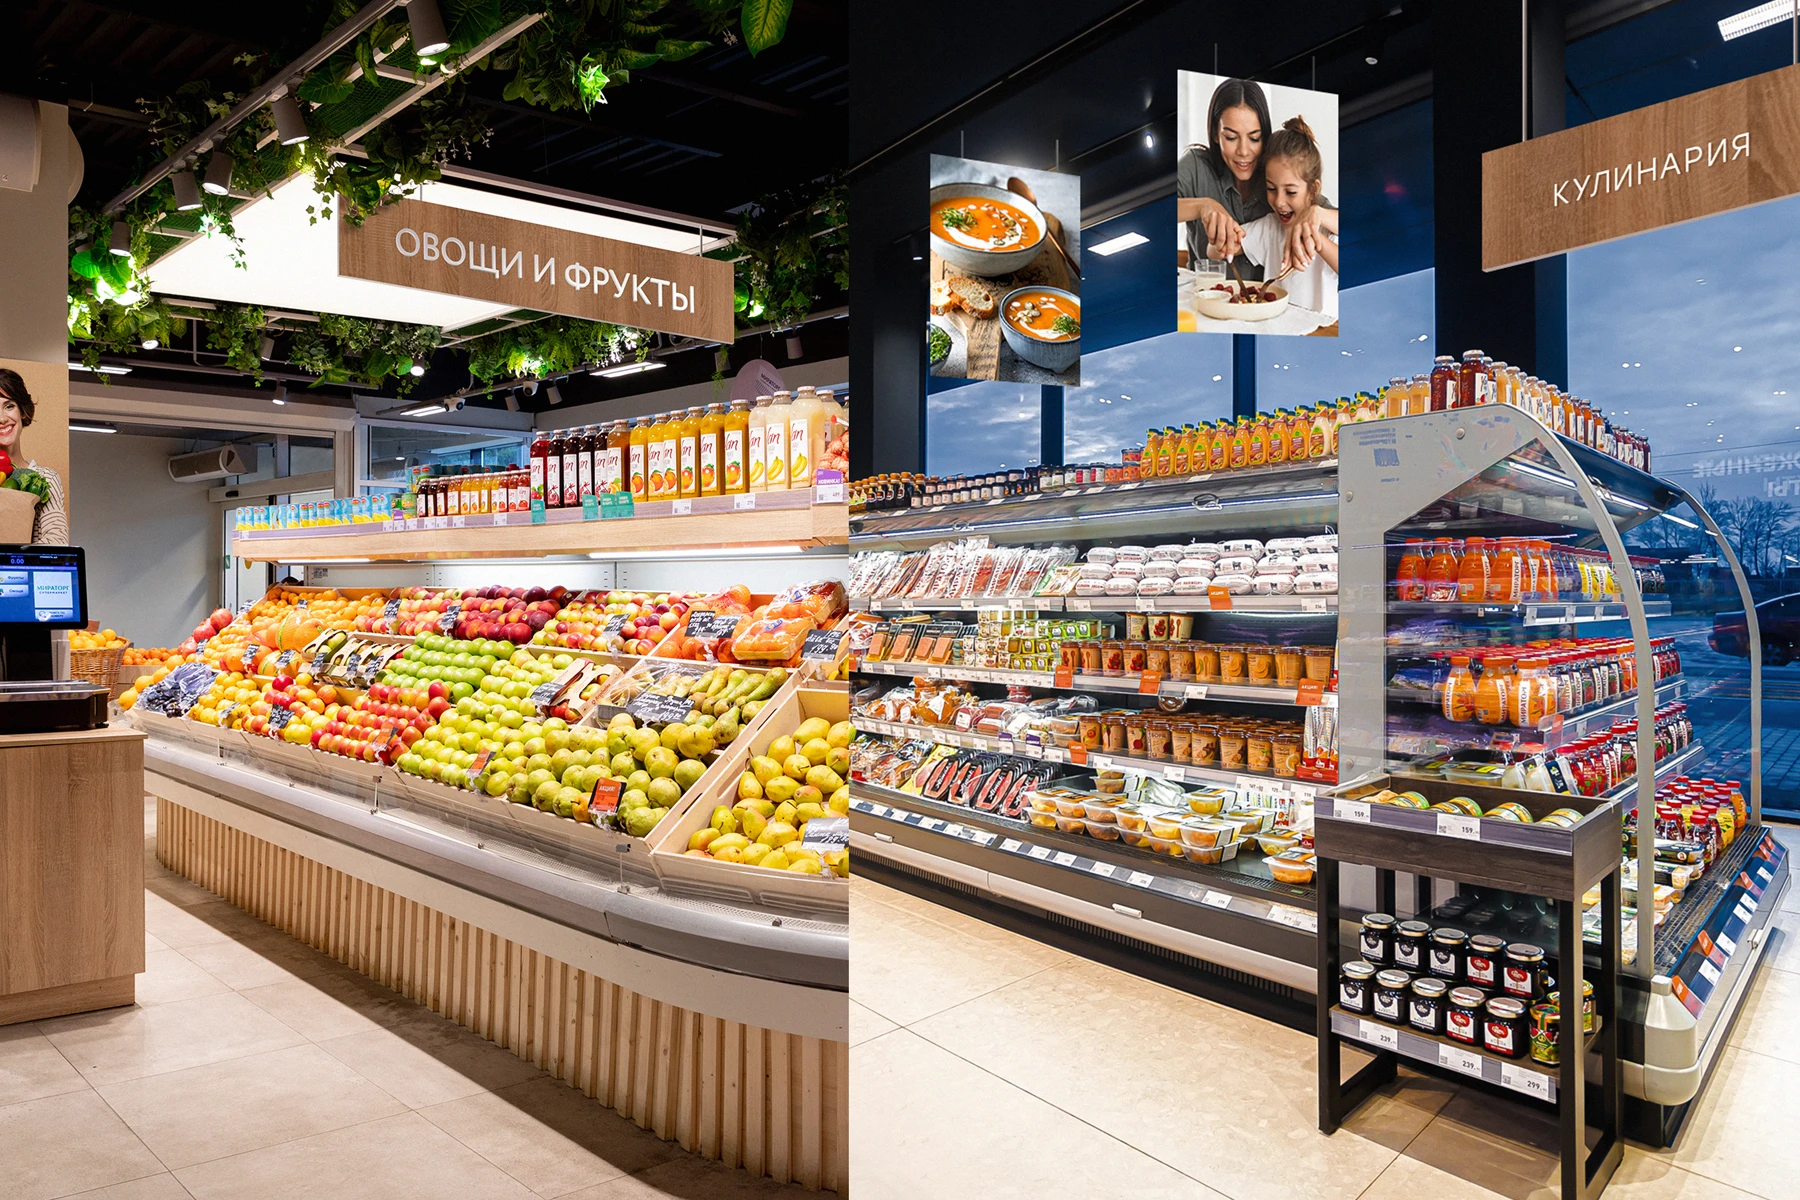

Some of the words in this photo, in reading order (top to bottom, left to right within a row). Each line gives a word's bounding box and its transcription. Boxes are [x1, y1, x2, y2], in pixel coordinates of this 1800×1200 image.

[1553, 131, 1750, 207] КУЛИНАРИЯ
[395, 227, 523, 279] ОВОЩИ
[533, 253, 556, 286] И
[564, 261, 695, 314] ФРУКТЫ
